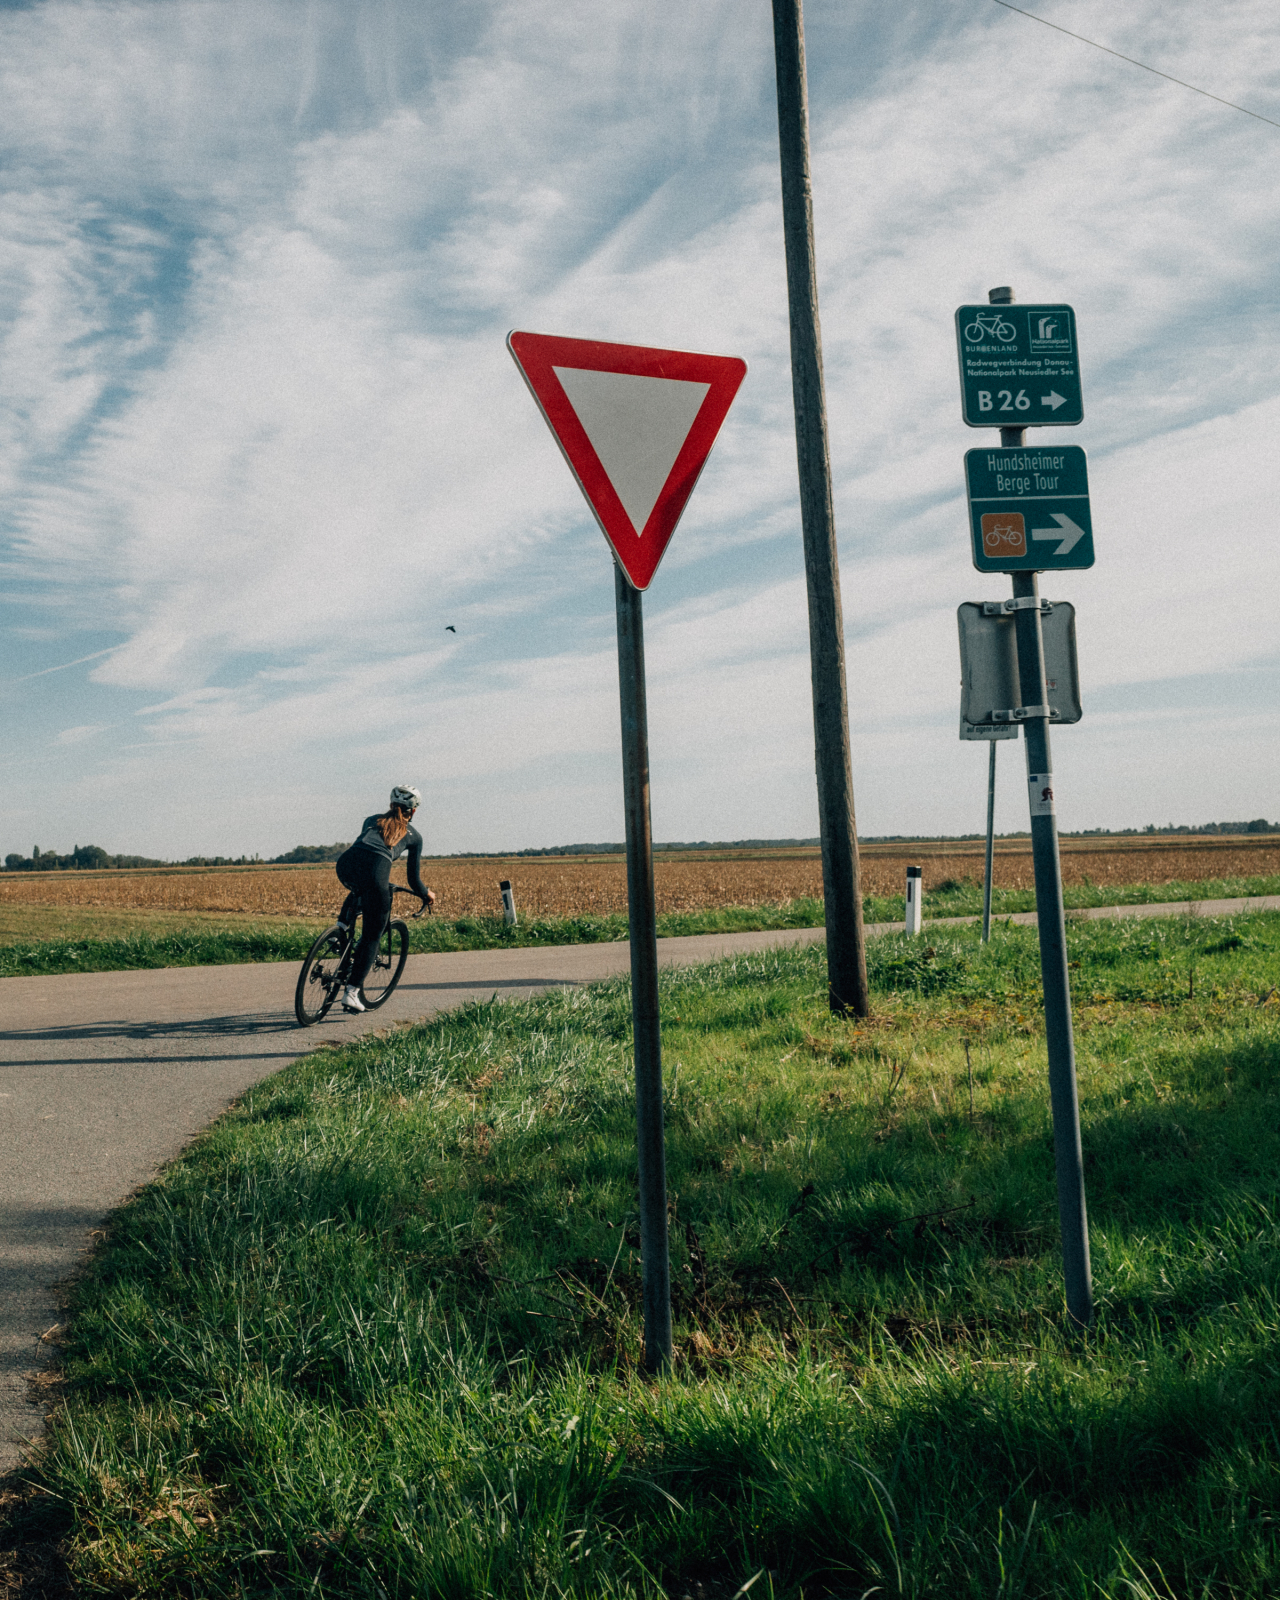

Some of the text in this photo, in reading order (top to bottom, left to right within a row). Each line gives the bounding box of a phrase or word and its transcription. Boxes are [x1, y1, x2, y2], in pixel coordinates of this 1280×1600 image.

[967, 359, 1042, 368] Radwegverbindung
[968, 369, 1016, 377] Nationalpark
[978, 390, 1031, 412] B 26
[987, 452, 1065, 472] Hundsheimer
[996, 473, 1059, 494] Berge Tour
